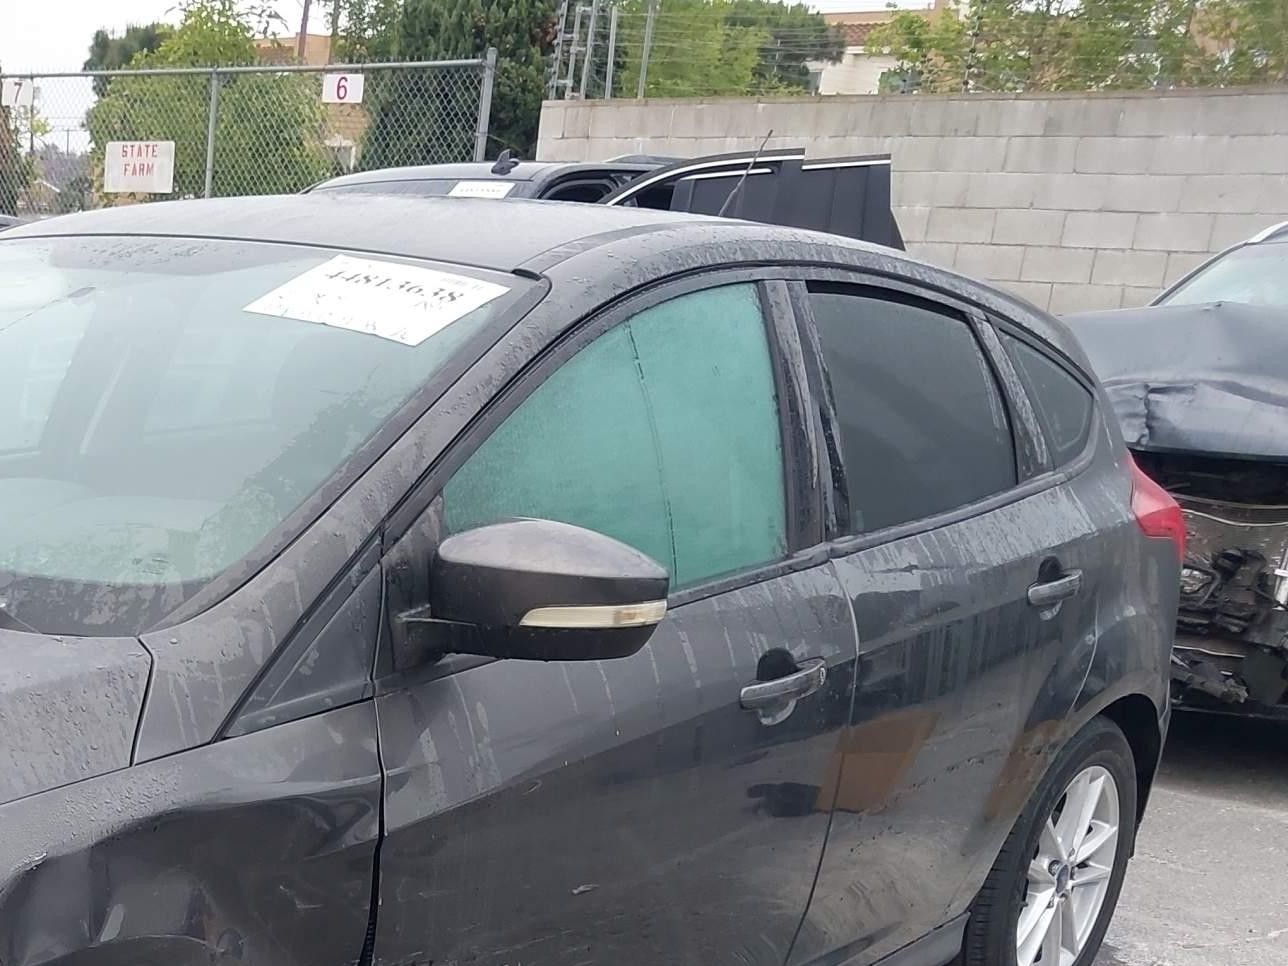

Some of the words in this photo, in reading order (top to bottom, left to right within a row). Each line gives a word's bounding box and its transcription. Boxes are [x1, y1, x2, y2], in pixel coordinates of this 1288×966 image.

[14, 82, 23, 104] 7
[337, 76, 348, 100] 6
[121, 144, 158, 158] STATE
[123, 163, 154, 176] FARM
[323, 269, 464, 302] 44813638
